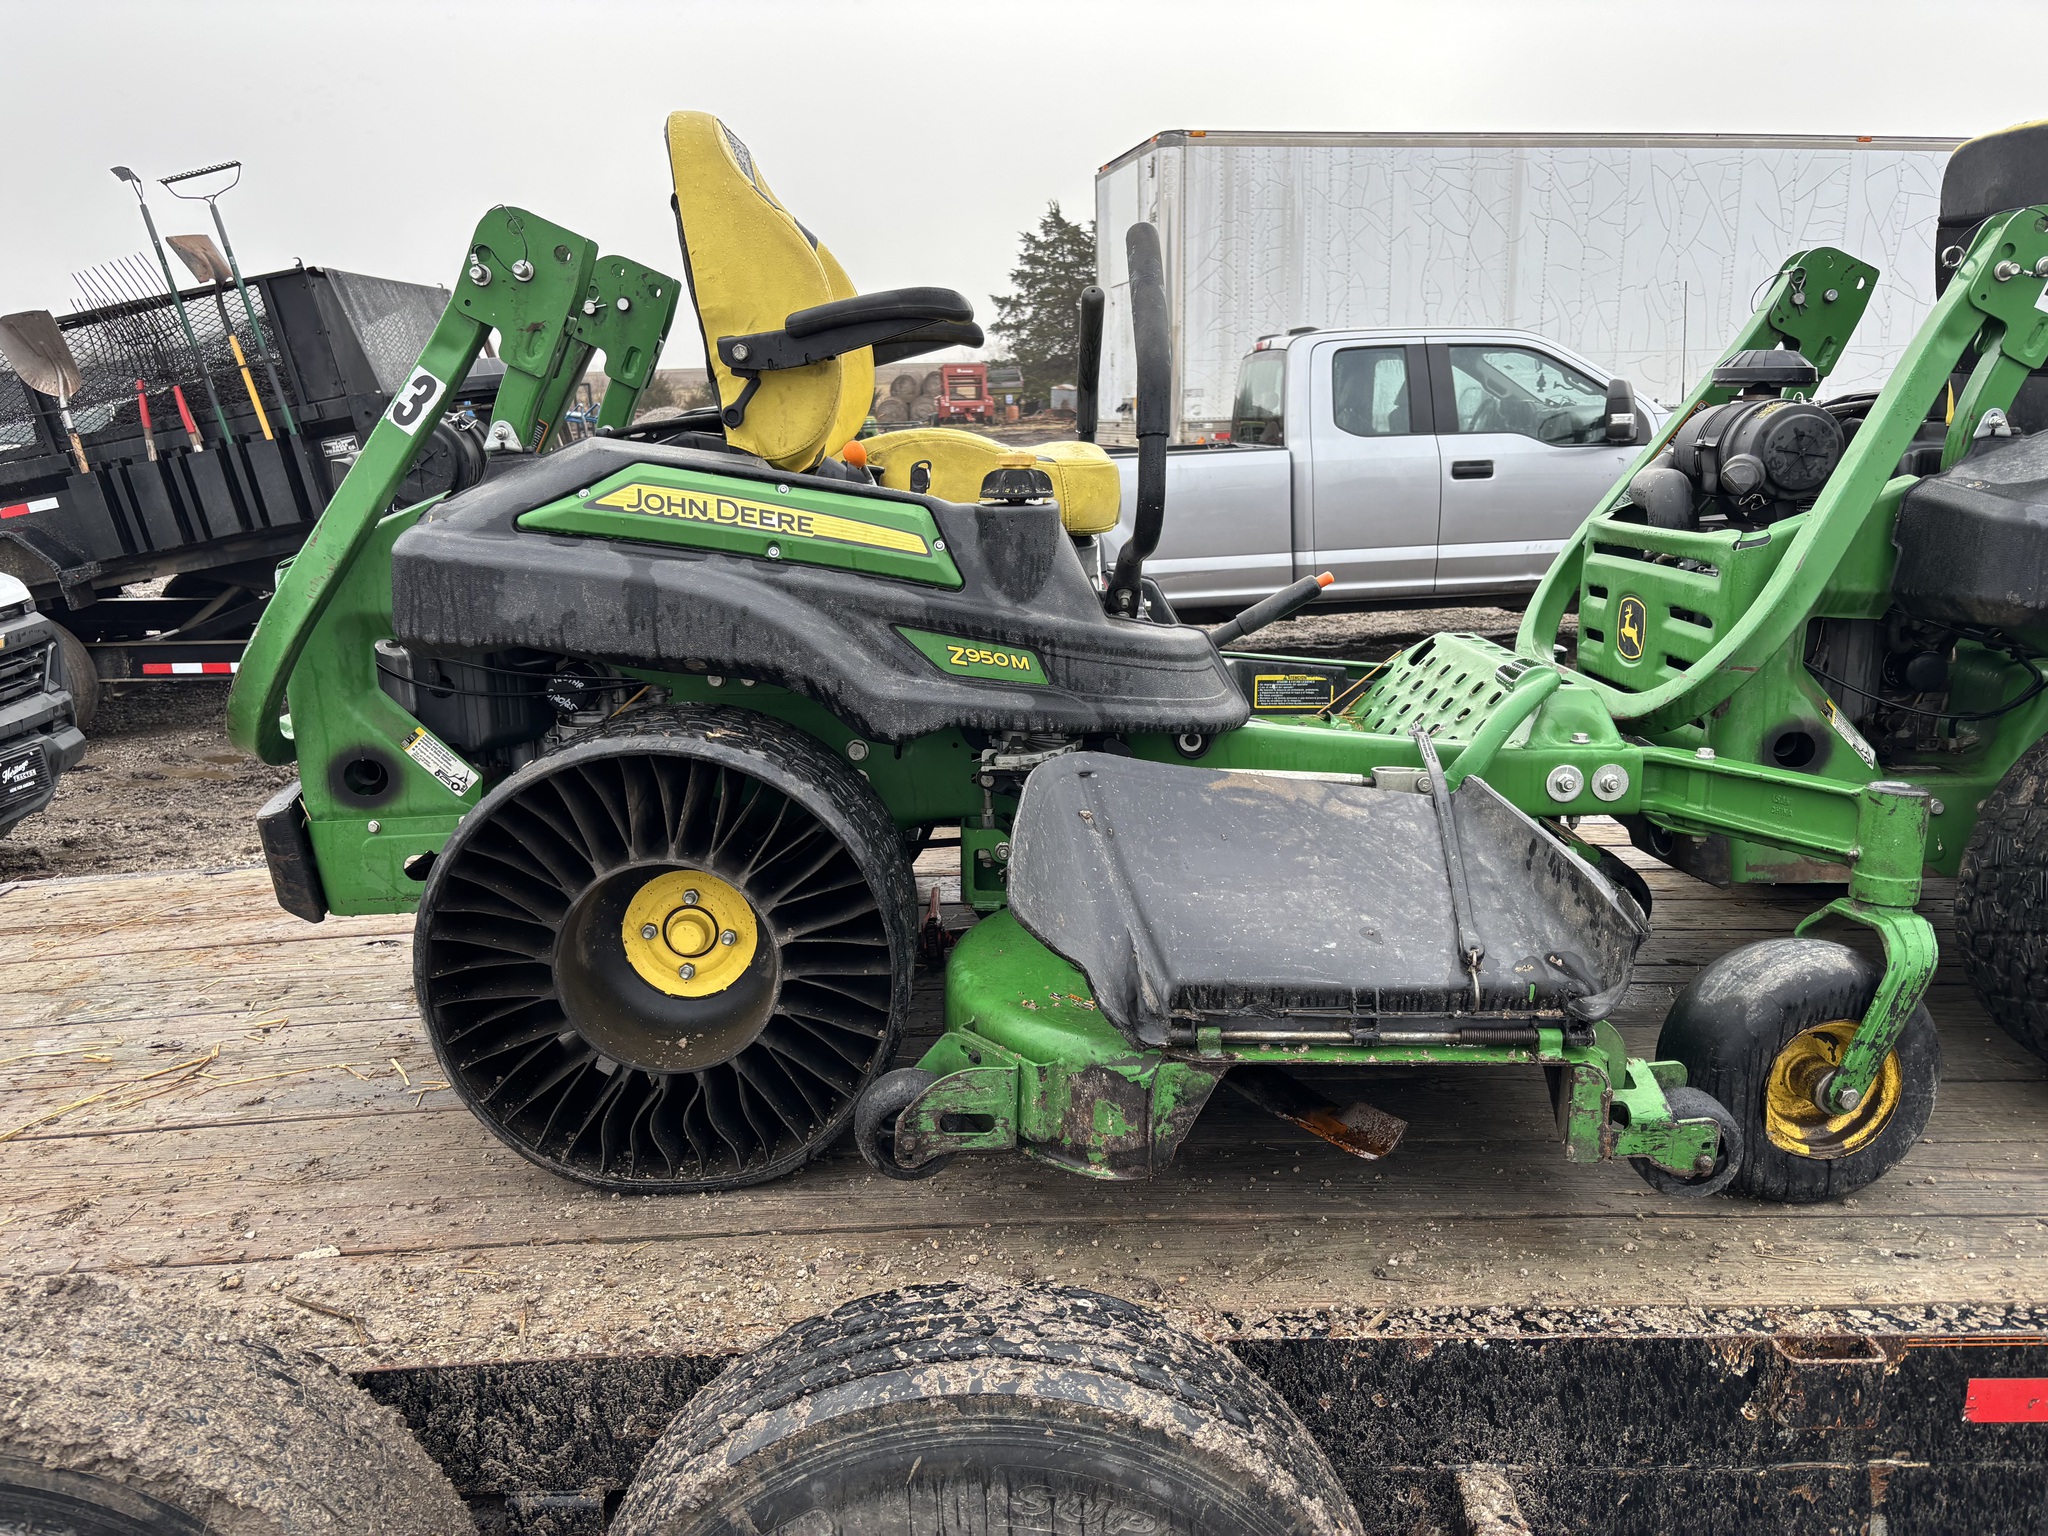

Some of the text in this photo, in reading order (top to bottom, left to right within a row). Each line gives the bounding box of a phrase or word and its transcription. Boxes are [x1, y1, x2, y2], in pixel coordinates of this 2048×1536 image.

[393, 375, 437, 426] 3
[626, 488, 815, 534] JOHN DEERE
[947, 645, 1031, 671] Z950M
[2, 760, 29, 784] Heritage
